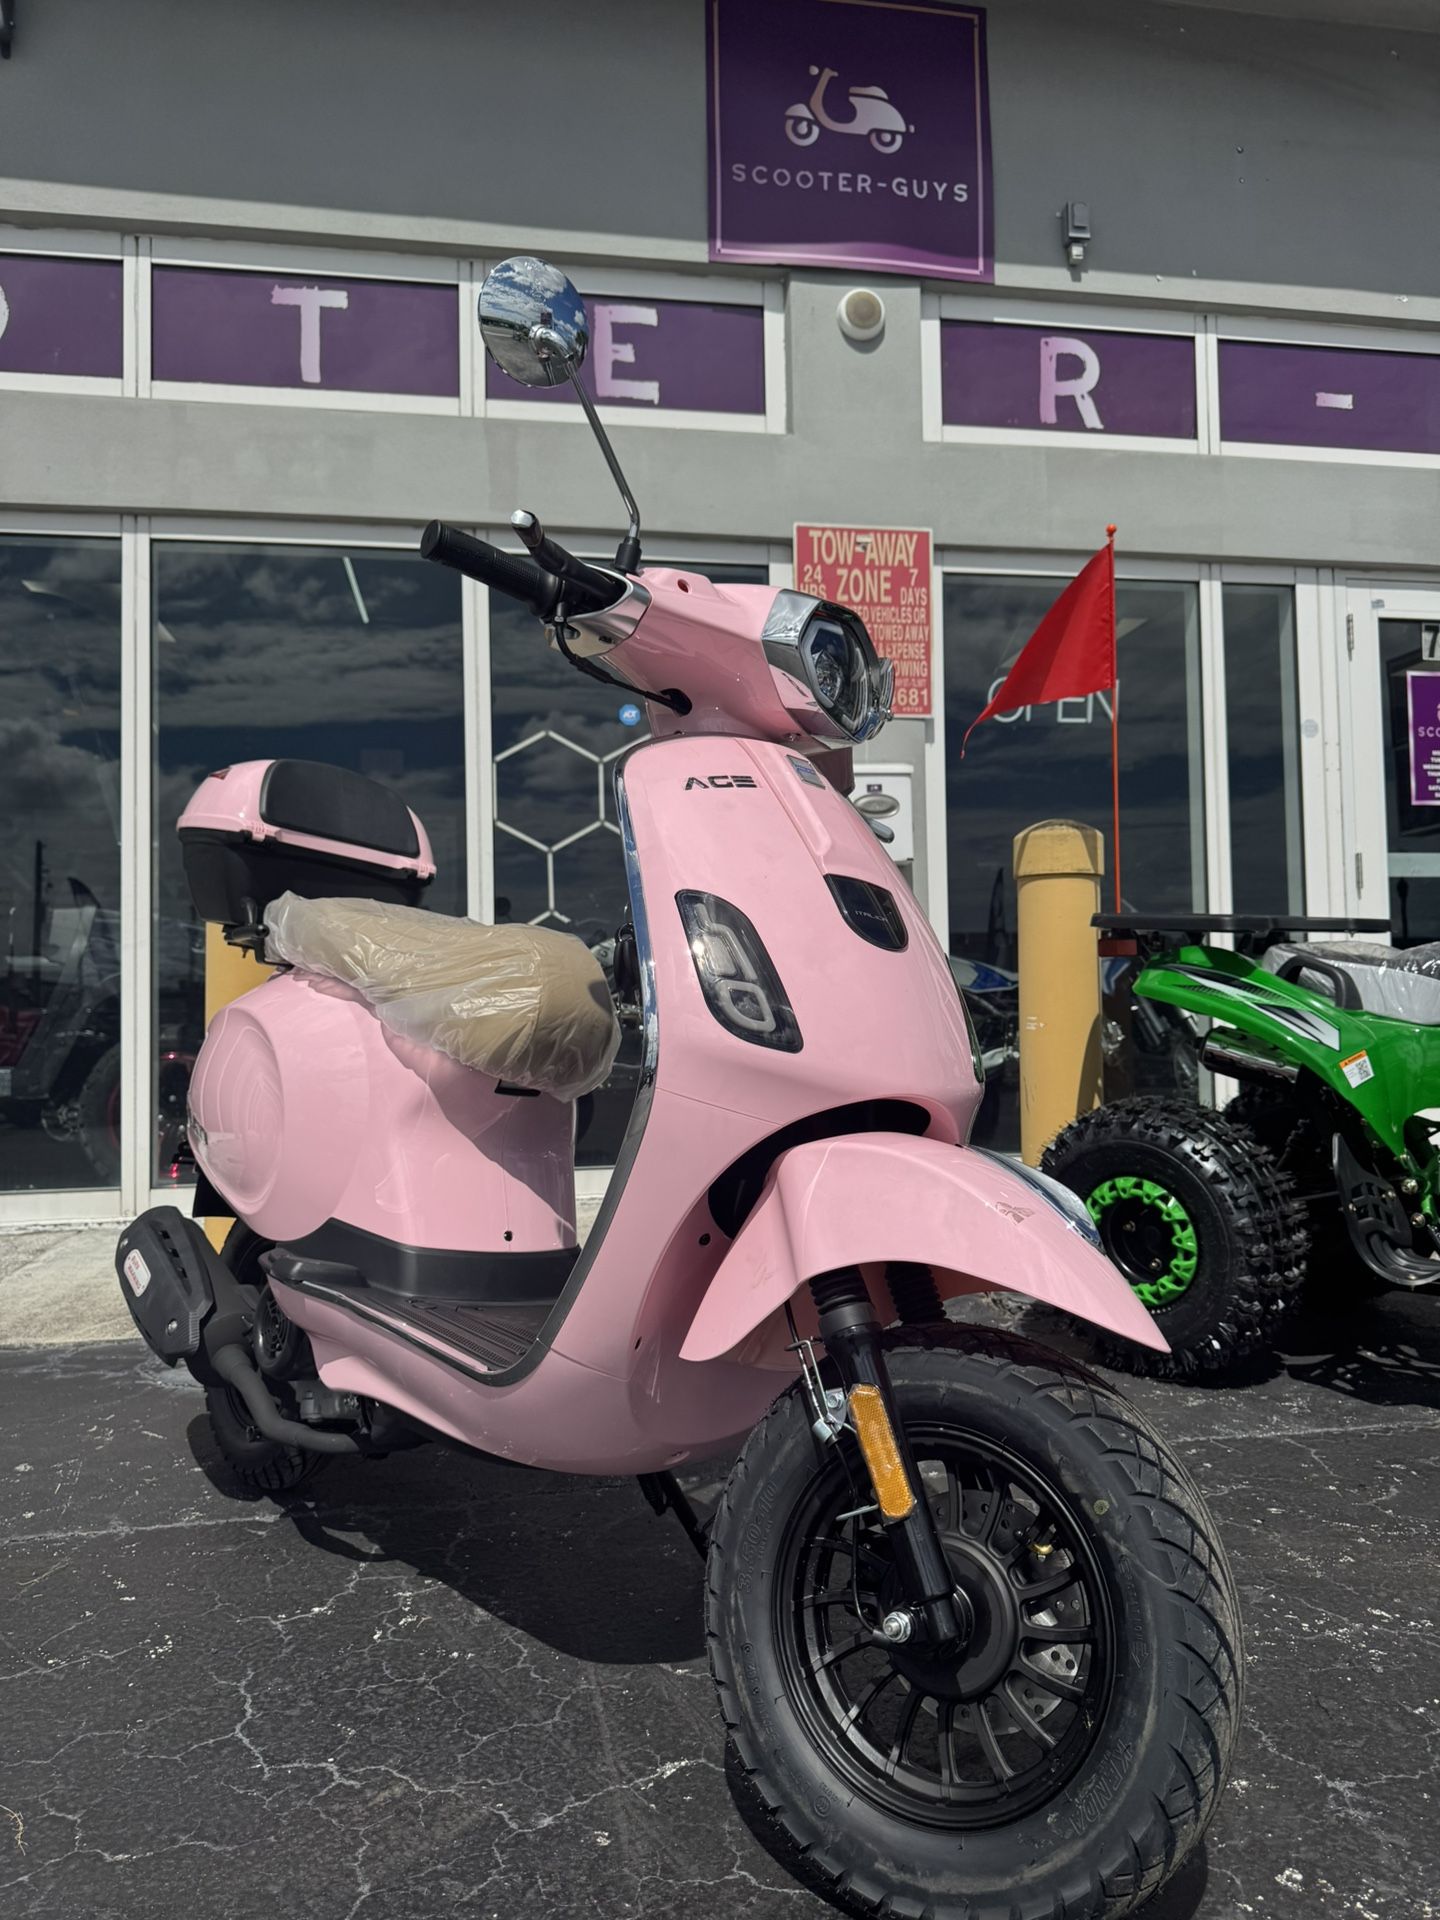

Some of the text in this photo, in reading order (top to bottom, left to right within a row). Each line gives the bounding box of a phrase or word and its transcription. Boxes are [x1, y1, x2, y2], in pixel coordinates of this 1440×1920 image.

[731, 162, 969, 202] SCOOTER-GUYS
[271, 284, 348, 384] T
[593, 303, 660, 405] E
[1039, 336, 1104, 429] R
[808, 529, 918, 568] TOW-AWAY
[803, 564, 918, 604] 24 ZONE 7
[900, 587, 927, 606] DAYS
[870, 606, 912, 624] VEHICLES
[913, 606, 927, 624] OR
[873, 624, 904, 641] TOWED
[904, 625, 930, 642] AWAY
[893, 660, 928, 677] OWING
[892, 687, 928, 707] 681
